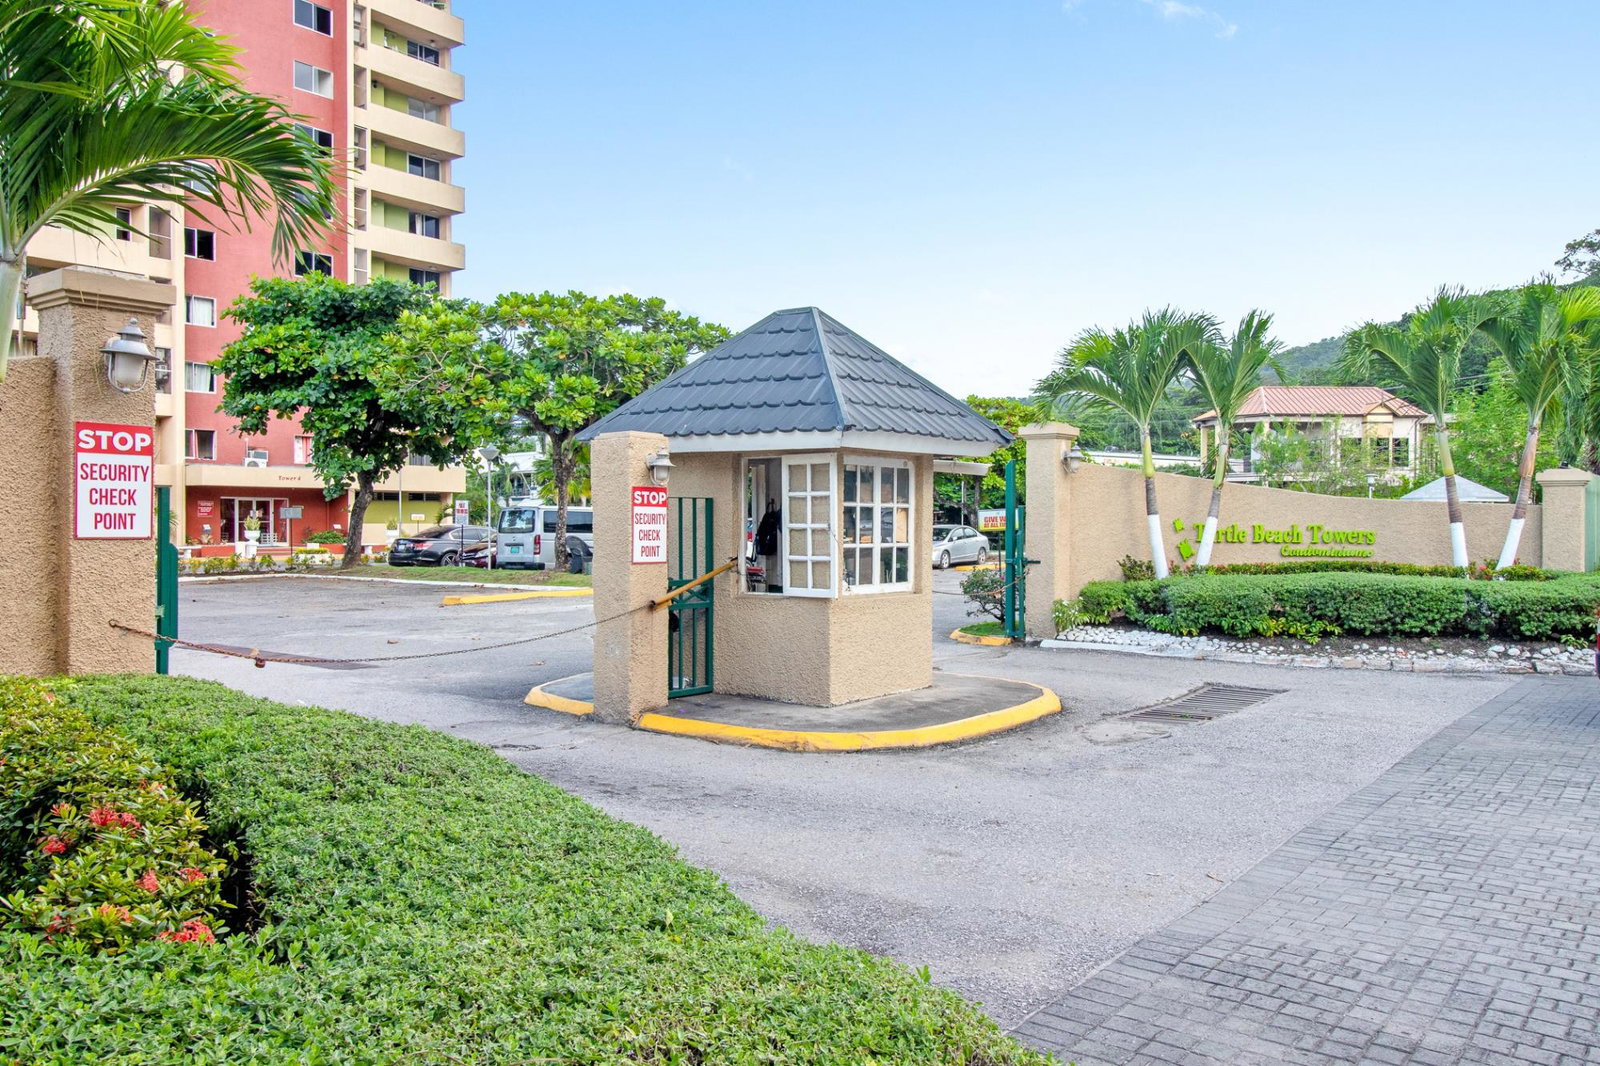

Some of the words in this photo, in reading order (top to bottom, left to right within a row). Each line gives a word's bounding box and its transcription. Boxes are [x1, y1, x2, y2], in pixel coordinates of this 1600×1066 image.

[78, 429, 151, 452] STOP
[80, 463, 149, 482] SECURITY
[89, 488, 137, 506] CHECK
[634, 490, 667, 504] STOP
[94, 512, 137, 530] POINT
[635, 513, 666, 525] SECURITY
[639, 529, 661, 541] CHECK
[1193, 522, 1248, 543] Trtle
[1253, 524, 1303, 544] Beach
[1308, 524, 1376, 544] Towers
[641, 546, 660, 557] POINT
[1280, 545, 1375, 557] Condominiums
